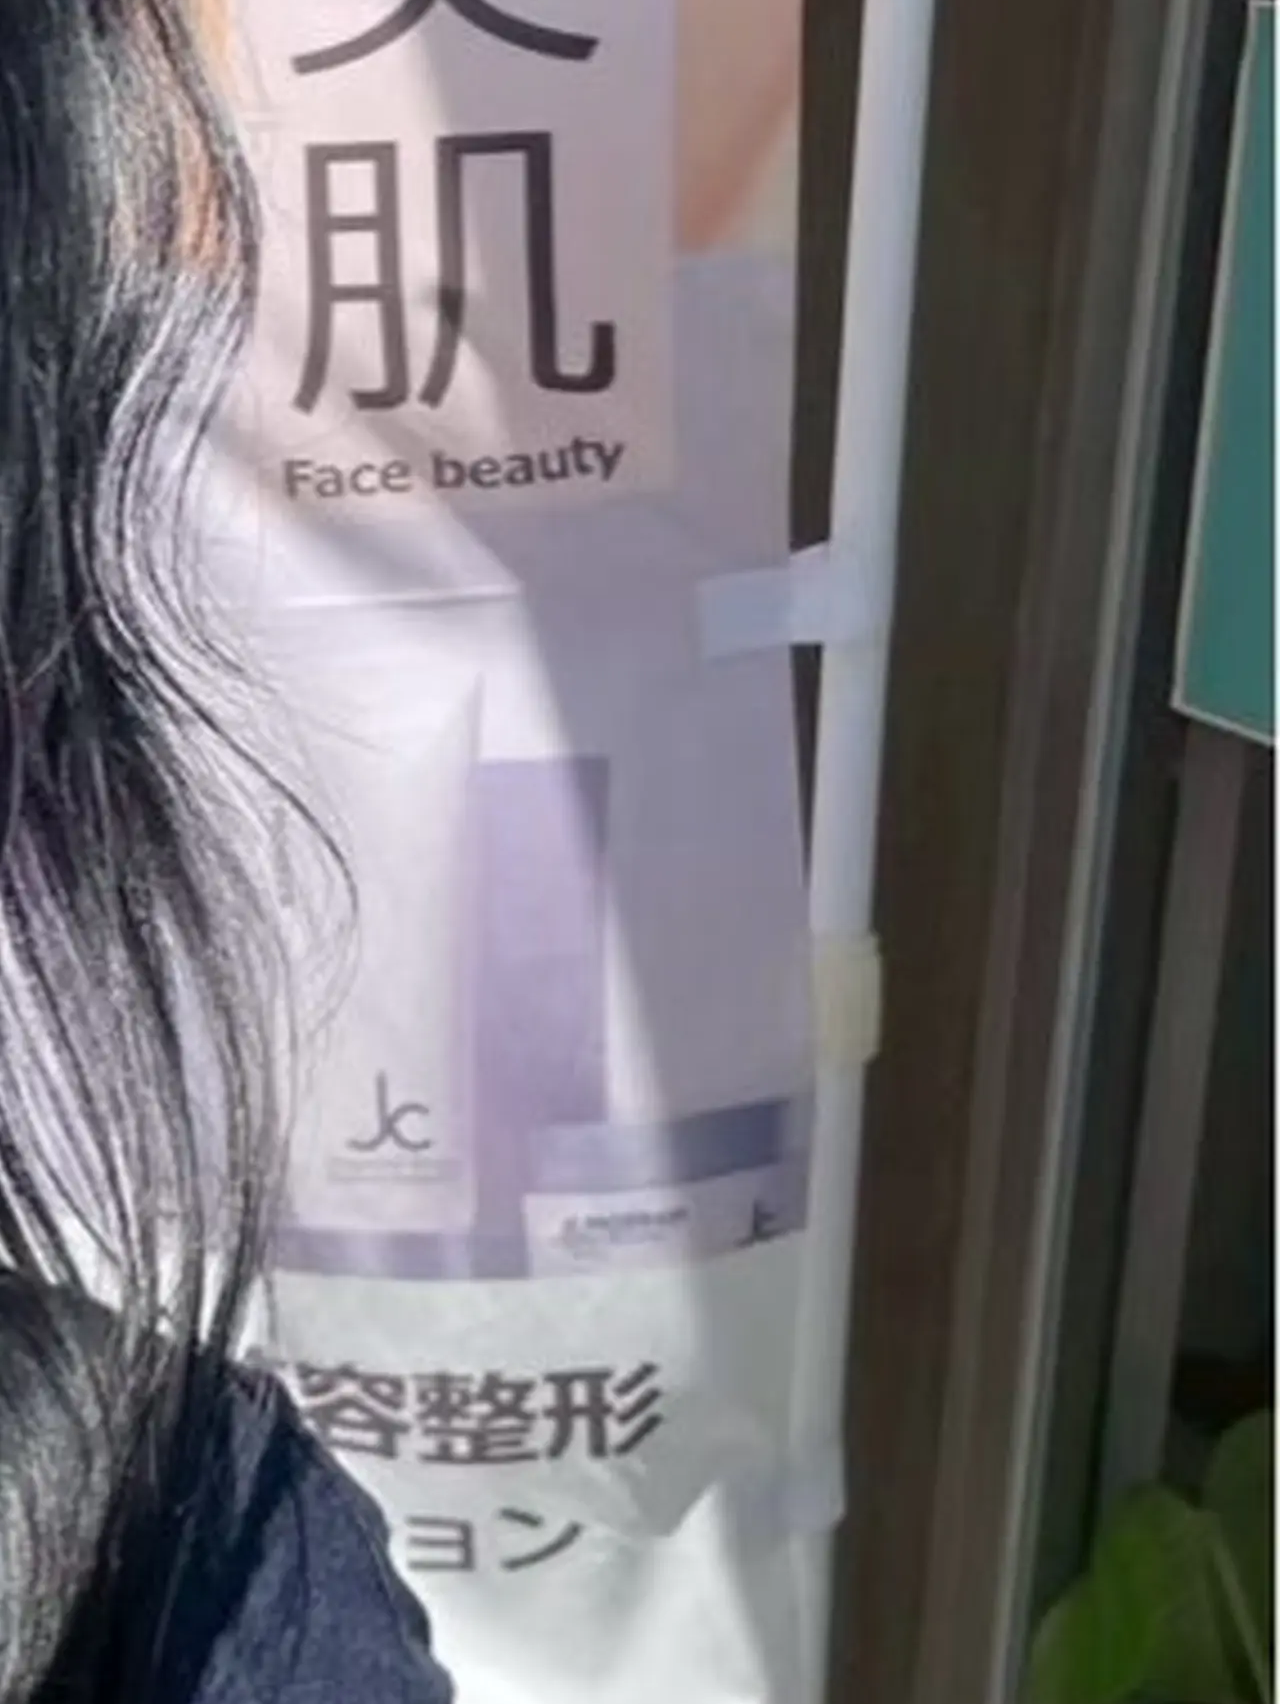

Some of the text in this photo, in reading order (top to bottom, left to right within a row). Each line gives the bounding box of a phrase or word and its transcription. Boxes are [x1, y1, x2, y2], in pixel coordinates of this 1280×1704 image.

[283, 436, 626, 501] Face beauty
[295, 1361, 664, 1464] 容整形
